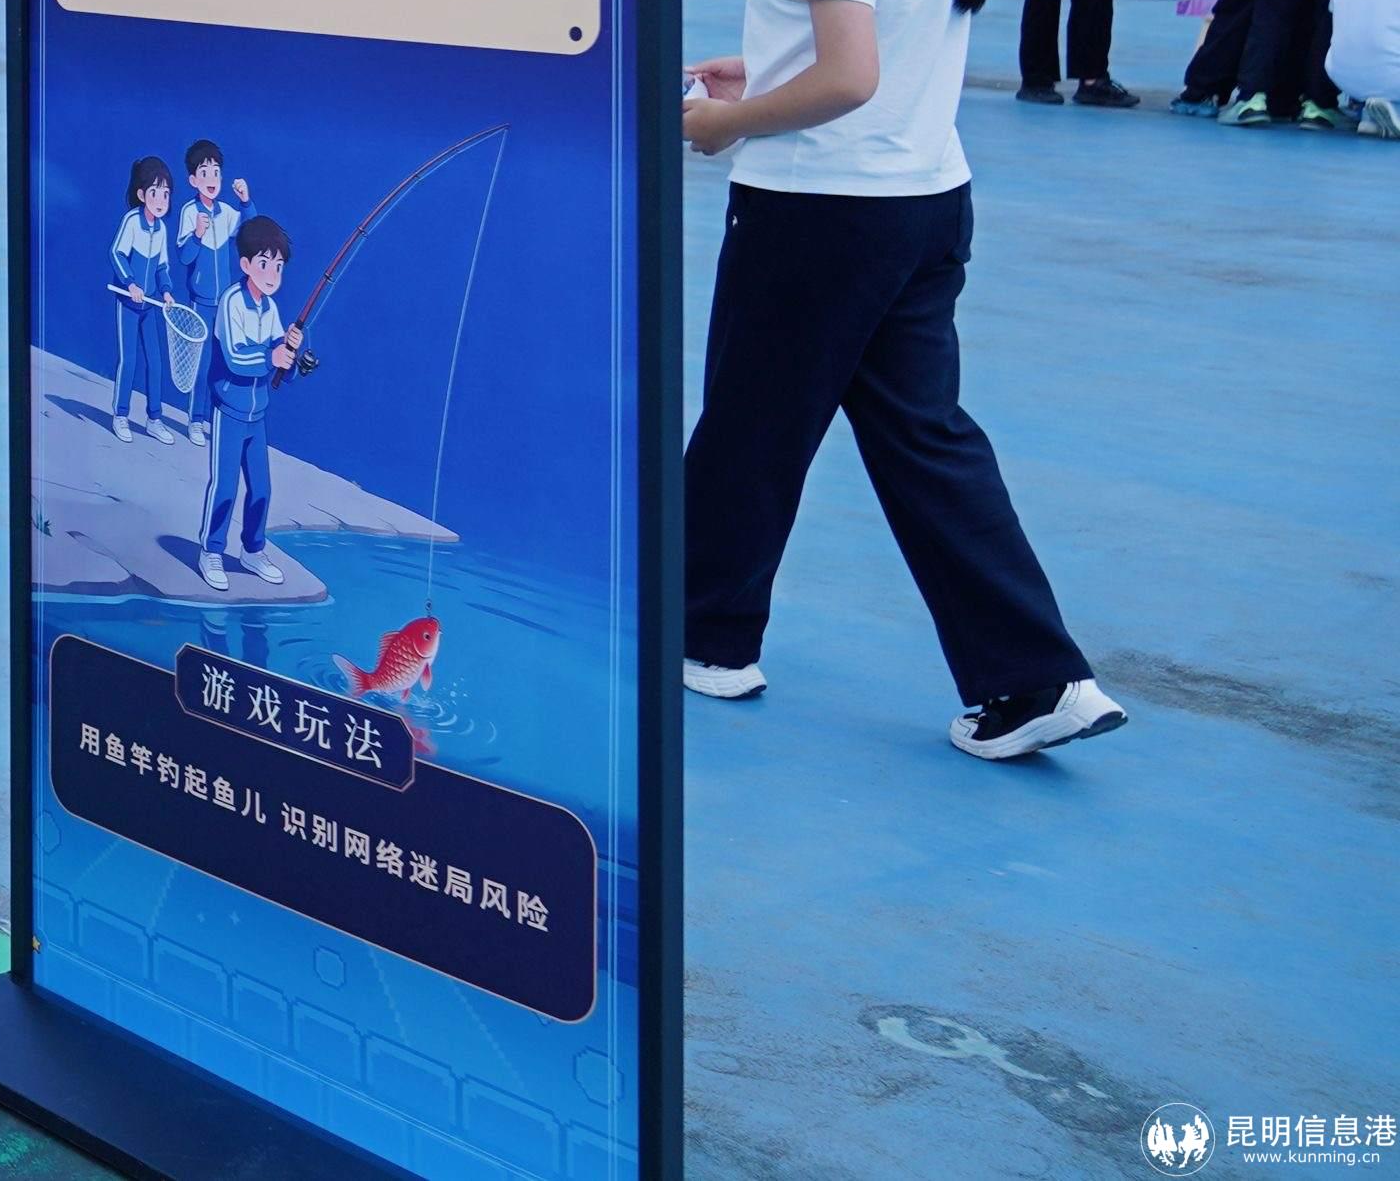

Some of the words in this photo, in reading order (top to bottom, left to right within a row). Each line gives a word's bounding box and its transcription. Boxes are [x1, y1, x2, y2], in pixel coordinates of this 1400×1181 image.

[201, 664, 383, 769] 游戏玩法
[79, 722, 267, 824] 用鱼竿钓起鱼儿
[281, 802, 550, 933] 识别网络迷局风险
